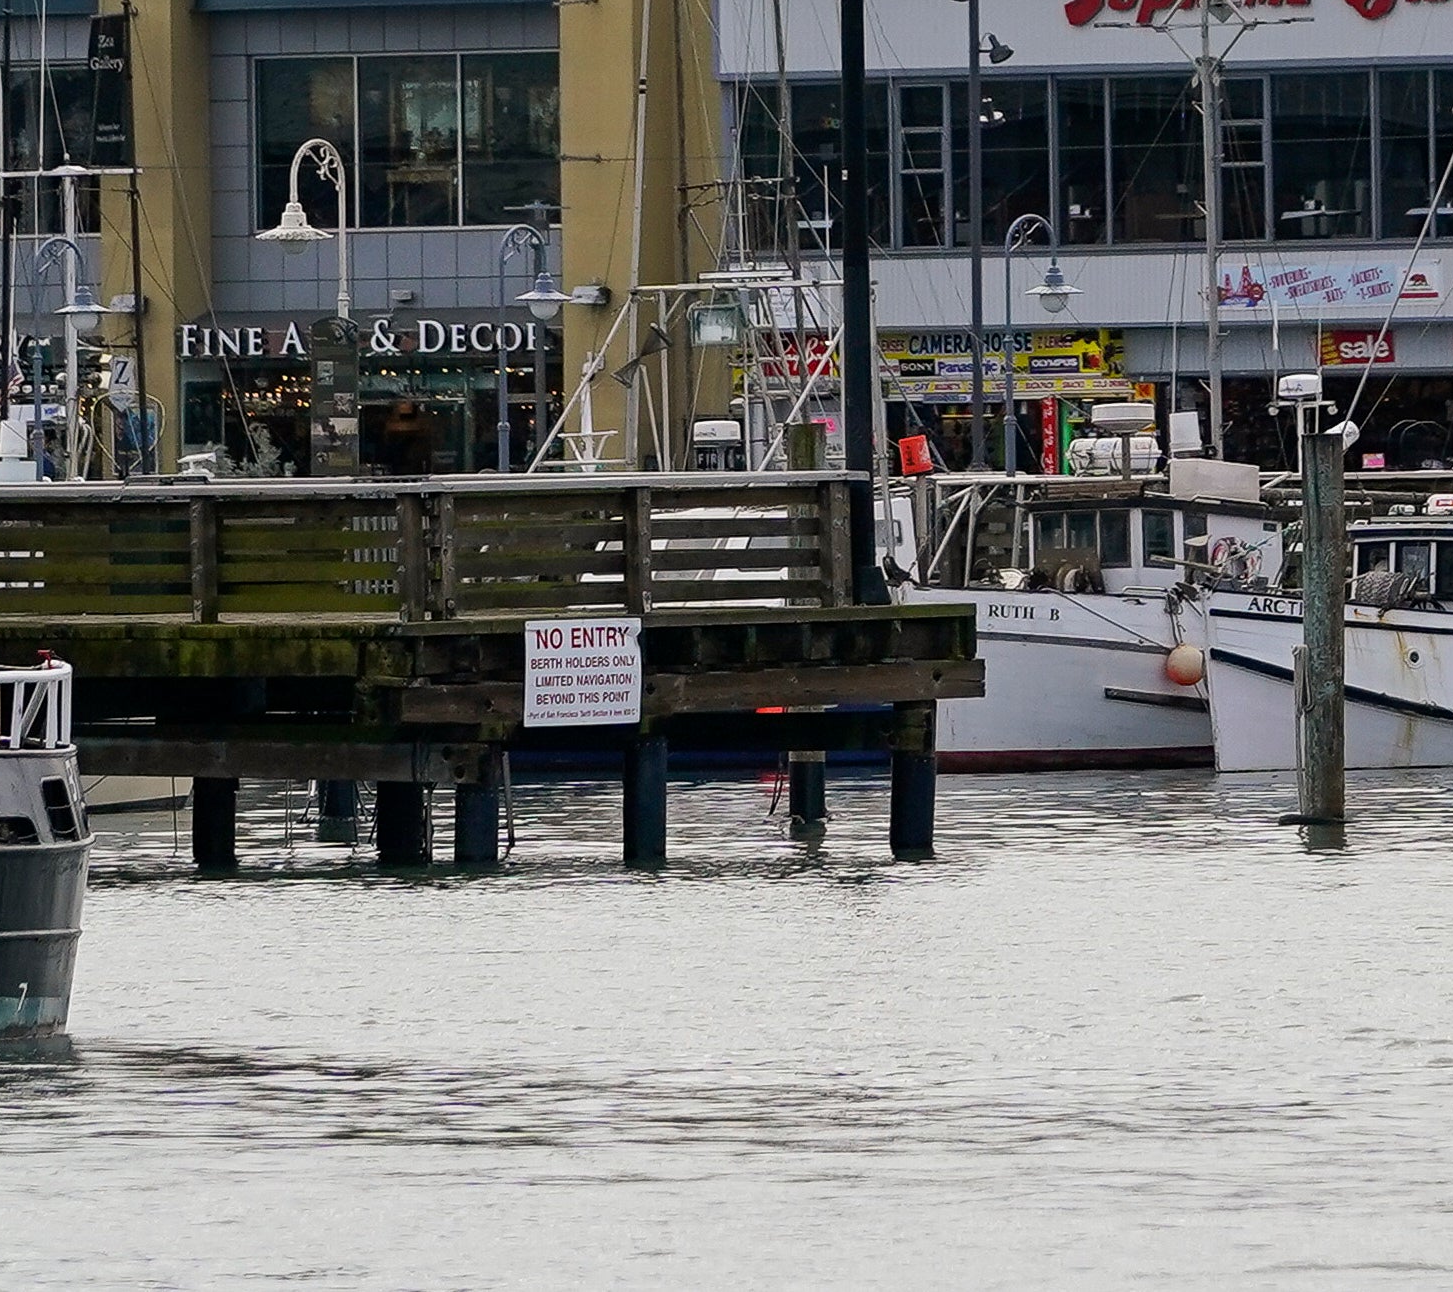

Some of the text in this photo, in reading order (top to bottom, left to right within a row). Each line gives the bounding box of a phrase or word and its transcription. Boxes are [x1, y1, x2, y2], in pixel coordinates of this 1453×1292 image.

[181, 323, 264, 358] FINE
[369, 319, 399, 352] &
[909, 331, 974, 354] CAMERA
[1338, 334, 1390, 359] sale
[900, 362, 934, 373] SONY
[988, 604, 1060, 621] RUTH B
[536, 626, 630, 650] NO ENTRY
[531, 655, 636, 670] BERTH HOLDERS ONLY
[536, 673, 632, 688] LIMITED NAVIGATION
[536, 691, 630, 705] BEYOND THIS POINT
